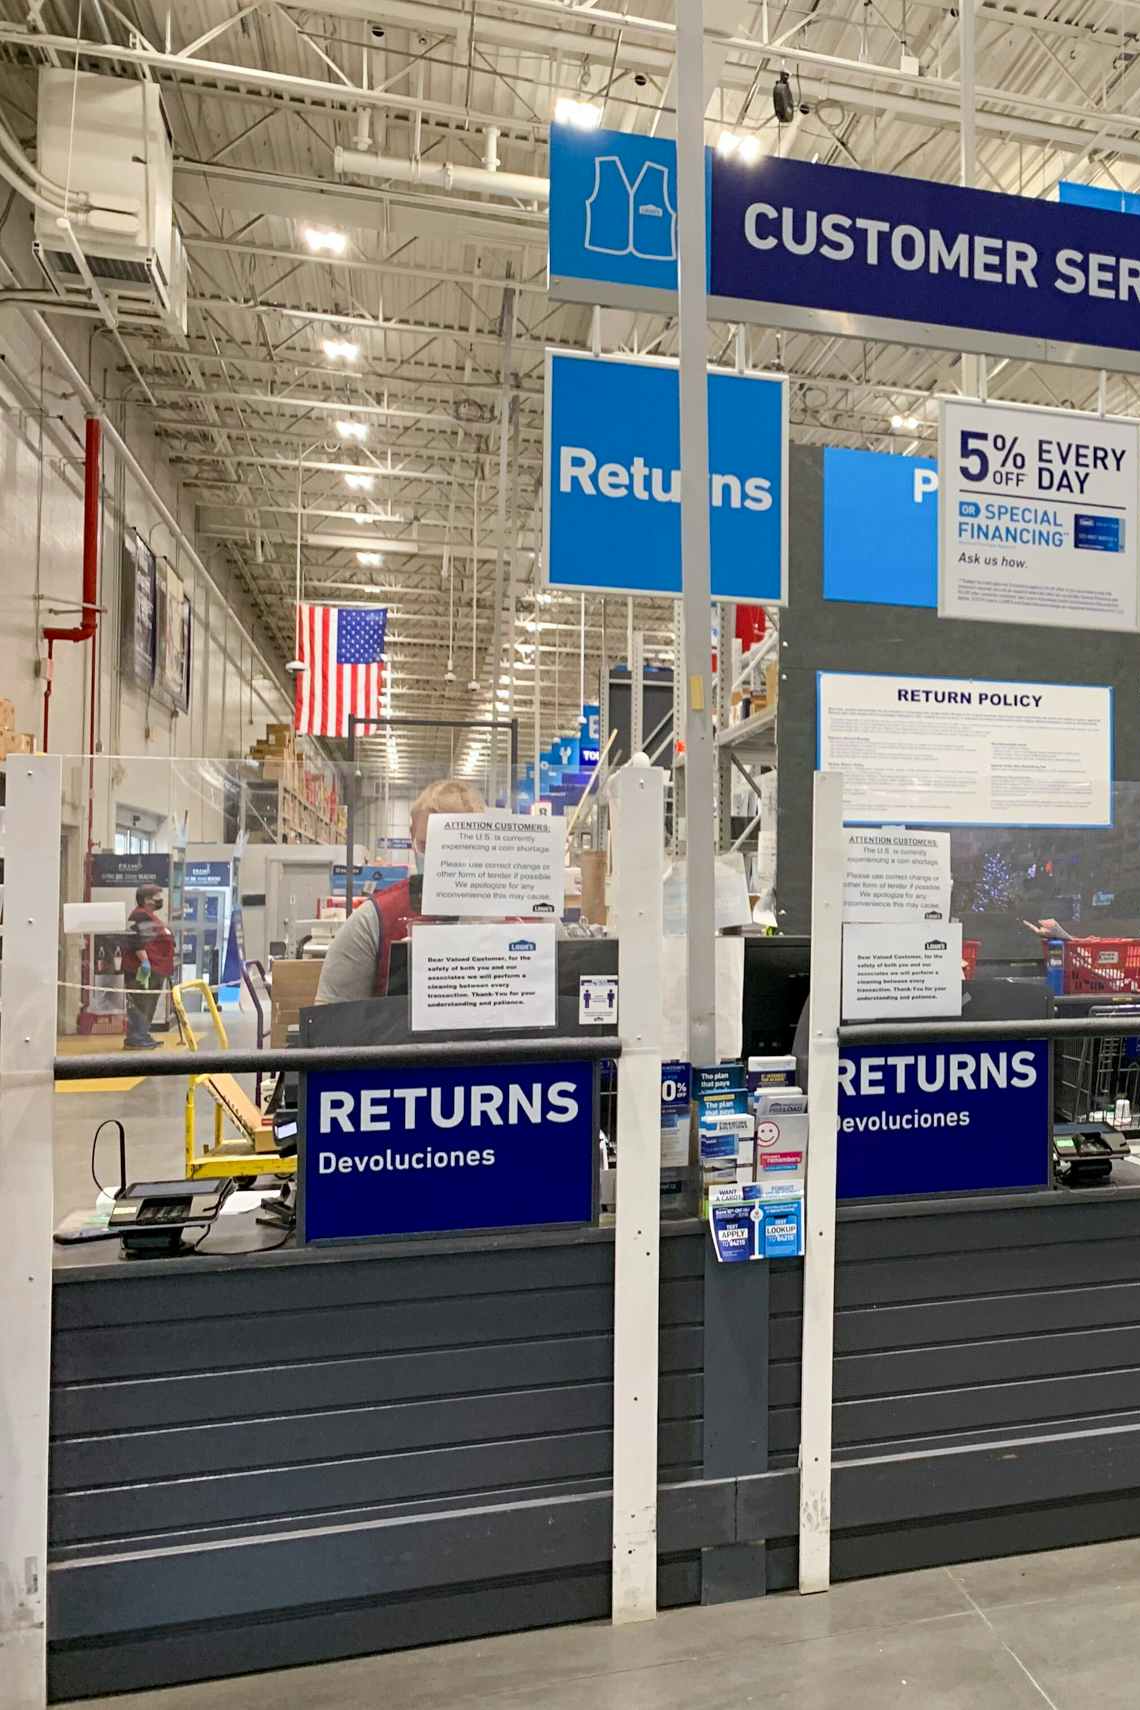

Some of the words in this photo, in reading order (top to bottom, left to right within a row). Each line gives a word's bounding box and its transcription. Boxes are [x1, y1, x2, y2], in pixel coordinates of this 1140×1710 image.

[744, 202, 1038, 289] CUSTOMER
[959, 430, 1026, 482] 5%
[1038, 439, 1126, 472] EVERY
[559, 446, 773, 512] Retuns
[1038, 467, 1090, 494] DAY
[985, 504, 1064, 527] SPECIAL
[958, 551, 980, 565] Ask
[984, 555, 998, 566] us
[897, 688, 973, 705] RETURN
[978, 693, 1042, 709] POLICY
[837, 1050, 1037, 1097] RETURNS
[319, 1081, 579, 1134] RETURNS
[836, 1109, 970, 1133] evoluciones
[319, 1147, 496, 1175] Devoluciones
[722, 1230, 745, 1239] APPLY
